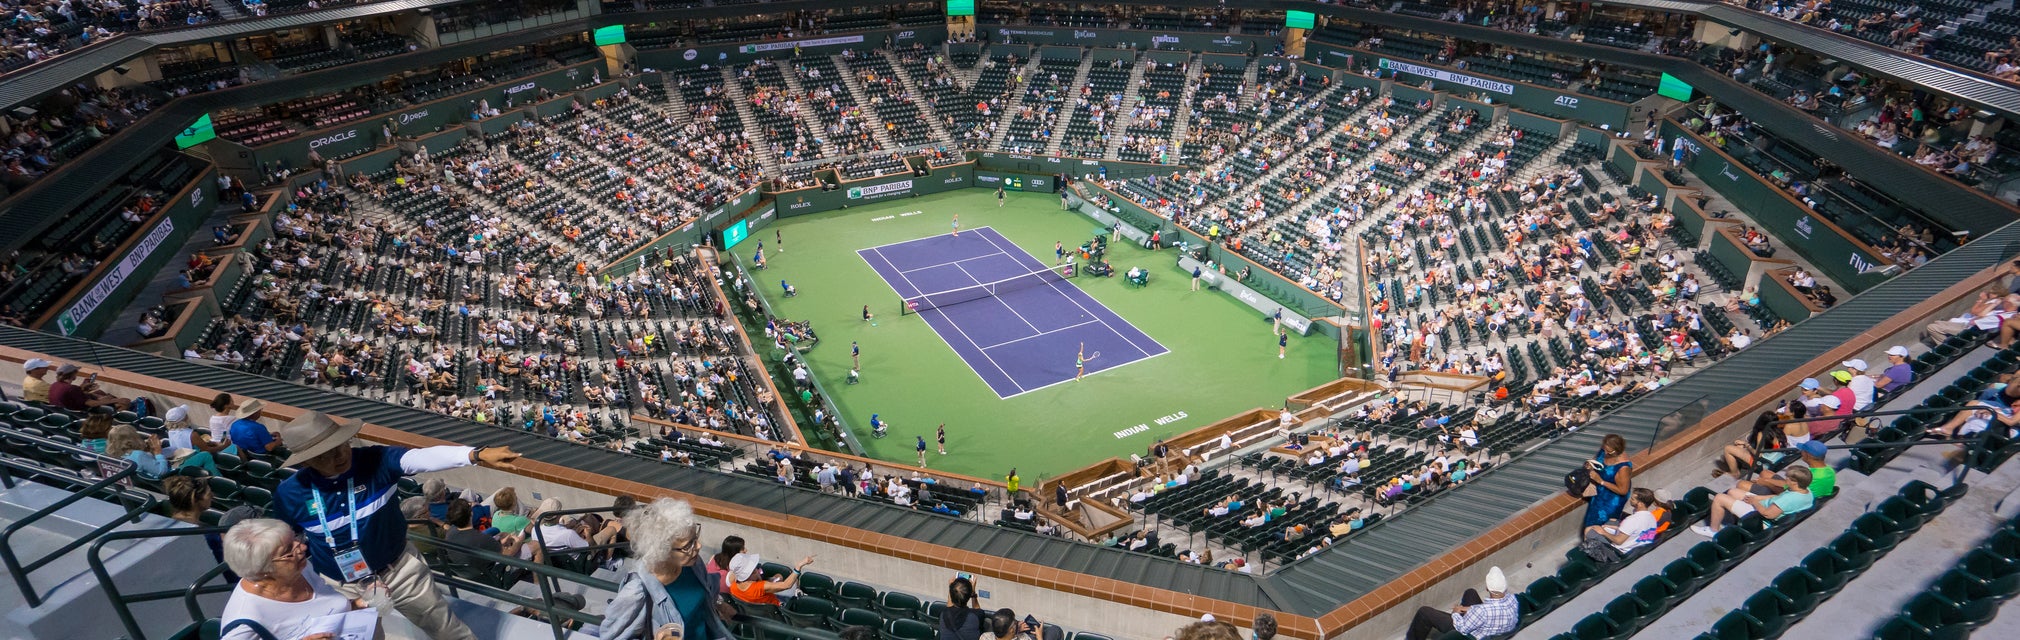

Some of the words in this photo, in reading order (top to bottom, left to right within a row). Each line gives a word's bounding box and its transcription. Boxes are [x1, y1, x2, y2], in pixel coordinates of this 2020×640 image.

[1390, 62, 1409, 72] BANK
[1416, 67, 1439, 77] WEST
[1450, 74, 1469, 84] BNP
[1470, 79, 1511, 93] PARIBAS
[504, 82, 535, 94] HEAD
[1555, 95, 1578, 105] ATP
[409, 109, 429, 122] pepsi
[309, 129, 357, 149] ORACLE
[863, 187, 878, 195] BNP
[880, 181, 910, 192] PARIBAS
[790, 202, 812, 210] ROLEX
[71, 291, 98, 323] BANK
[100, 266, 123, 295] WEST
[129, 245, 144, 267] BNP
[144, 219, 172, 253] PARIBAS
[1113, 423, 1150, 439] INDIAN
[1154, 410, 1189, 426] WELLS
